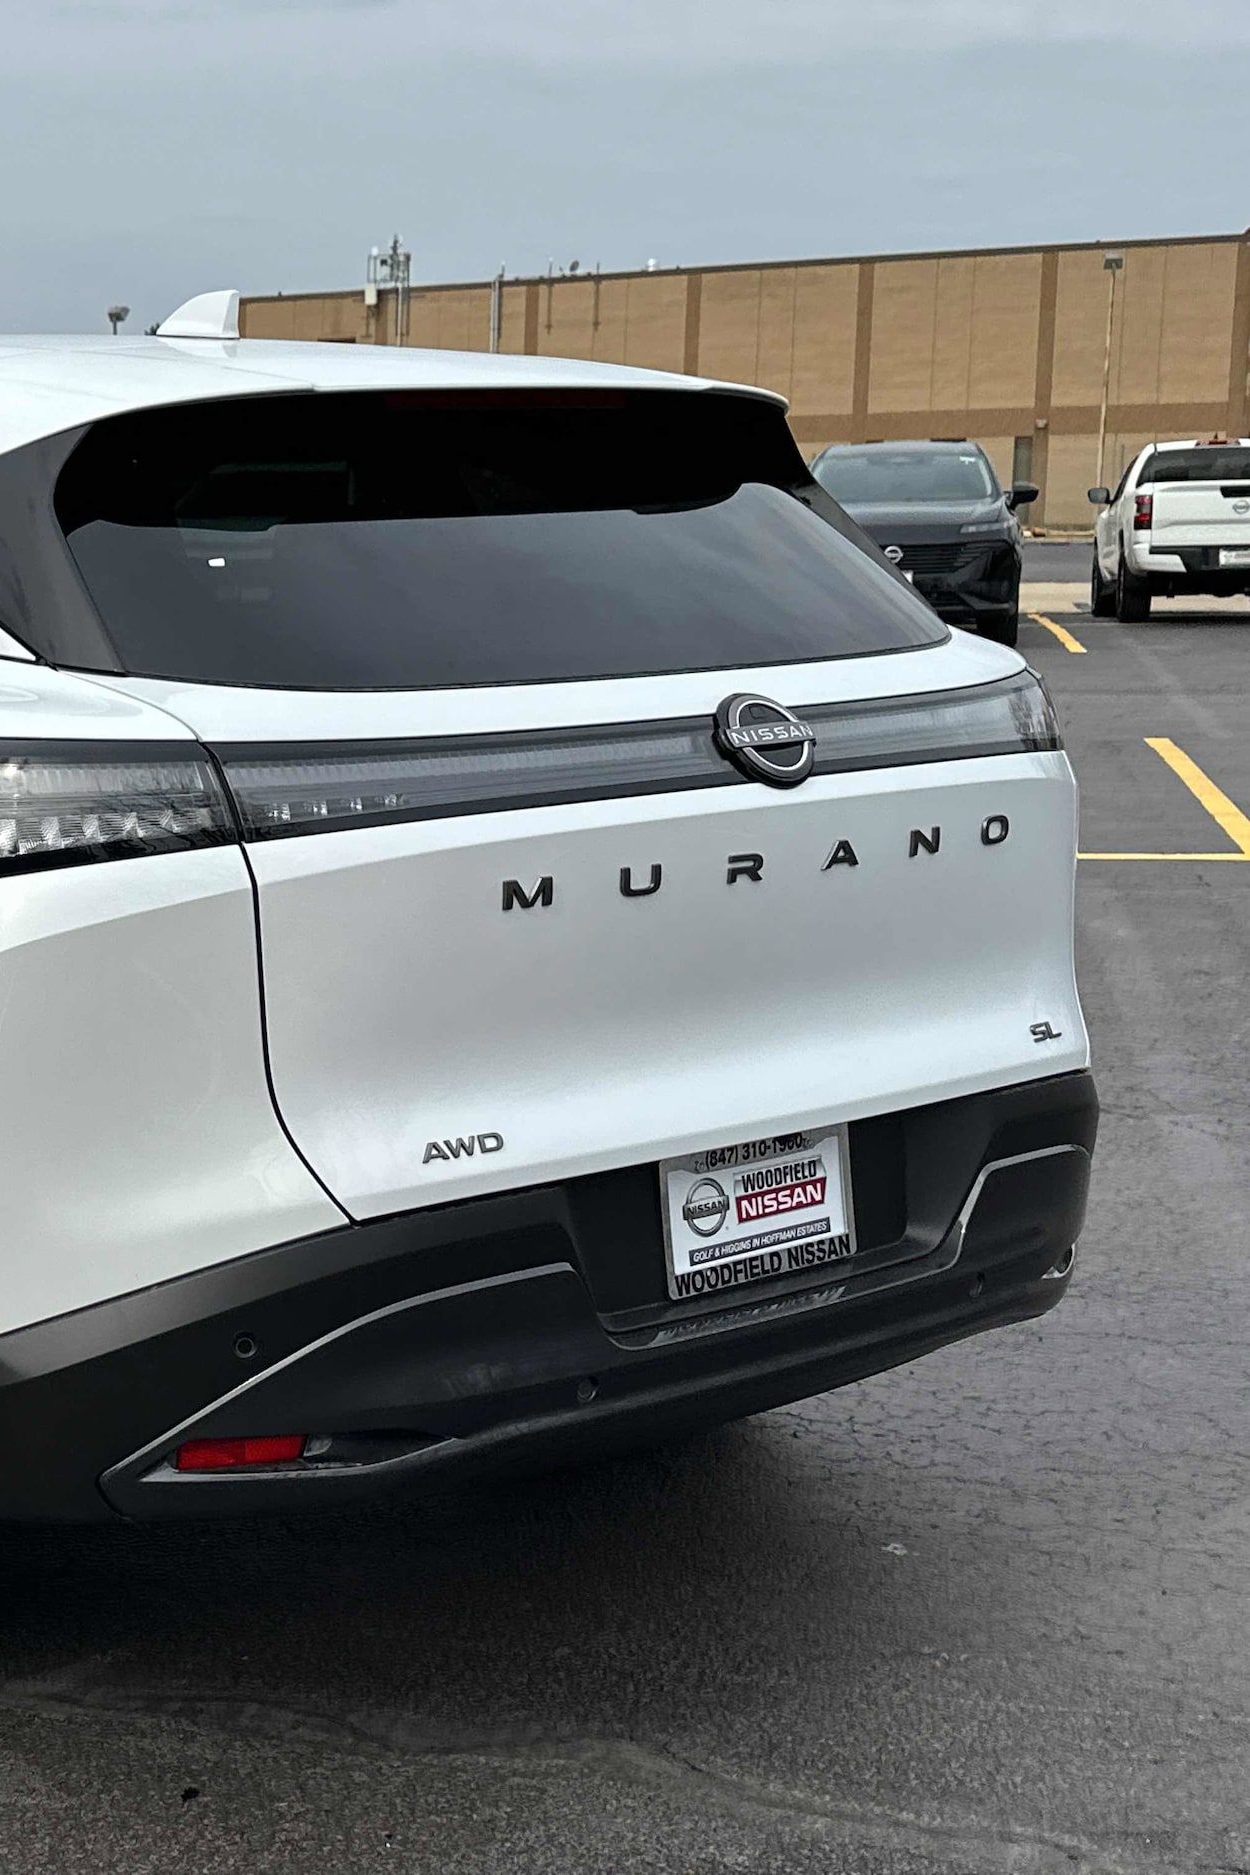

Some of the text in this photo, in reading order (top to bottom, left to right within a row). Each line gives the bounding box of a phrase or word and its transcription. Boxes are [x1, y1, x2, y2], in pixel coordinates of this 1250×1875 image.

[731, 725, 814, 744] NISSAN
[502, 815, 1009, 911] MURANO
[1029, 1021, 1062, 1043] SL
[422, 1132, 504, 1164] AWD
[705, 1144, 739, 1171] (847)
[741, 1159, 818, 1194] WOODFIELD
[688, 1199, 727, 1216] NISSAN
[740, 1182, 823, 1219] NISSAN
[693, 1249, 713, 1262] GOLF
[752, 1237, 760, 1248] IN
[761, 1230, 796, 1246] HOFFMAN
[796, 1221, 828, 1236] ESTATES
[674, 1234, 851, 1297] WOODFIELD NISSAN
